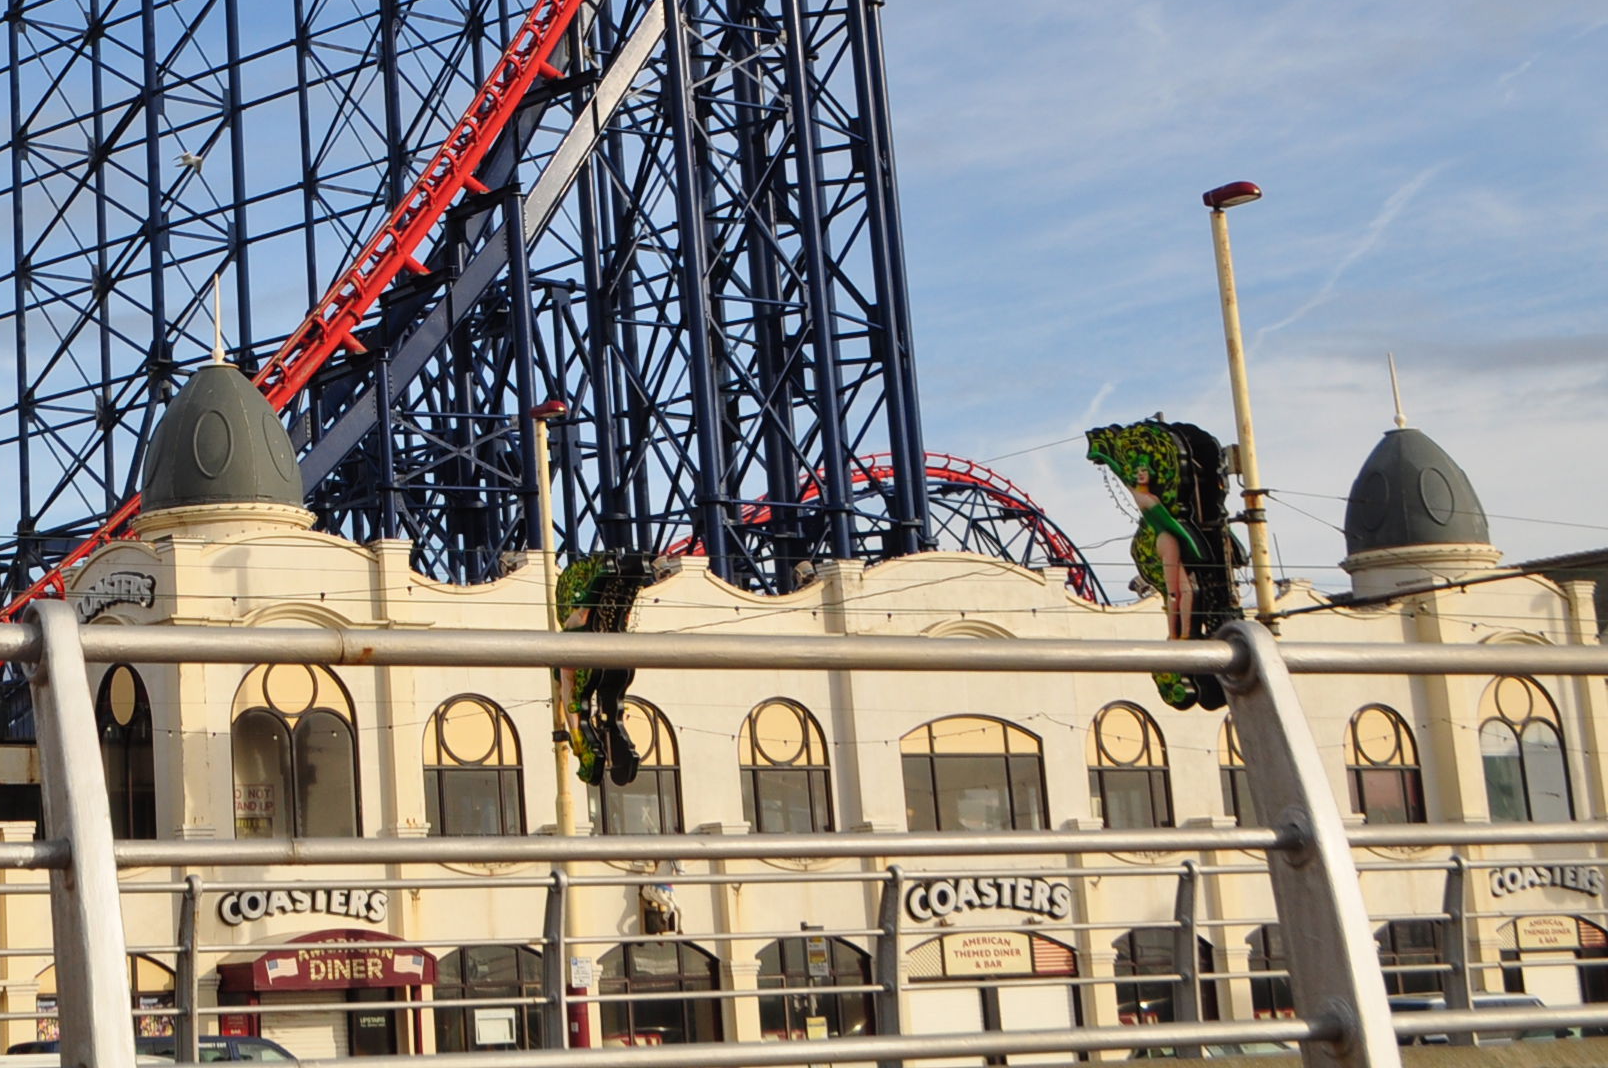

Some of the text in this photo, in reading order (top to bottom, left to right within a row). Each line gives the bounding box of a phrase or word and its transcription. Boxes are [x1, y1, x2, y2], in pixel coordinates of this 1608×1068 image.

[76, 572, 156, 624] COASTERS
[248, 788, 270, 799] NOT
[235, 800, 257, 811] AND
[1490, 866, 1604, 897] COASTERS
[219, 889, 389, 925] COASTERS
[906, 878, 1072, 923] COASTERS
[962, 936, 1011, 948] AMERICAN
[954, 948, 1022, 959] THEMED DINER
[309, 958, 384, 980] DINER
